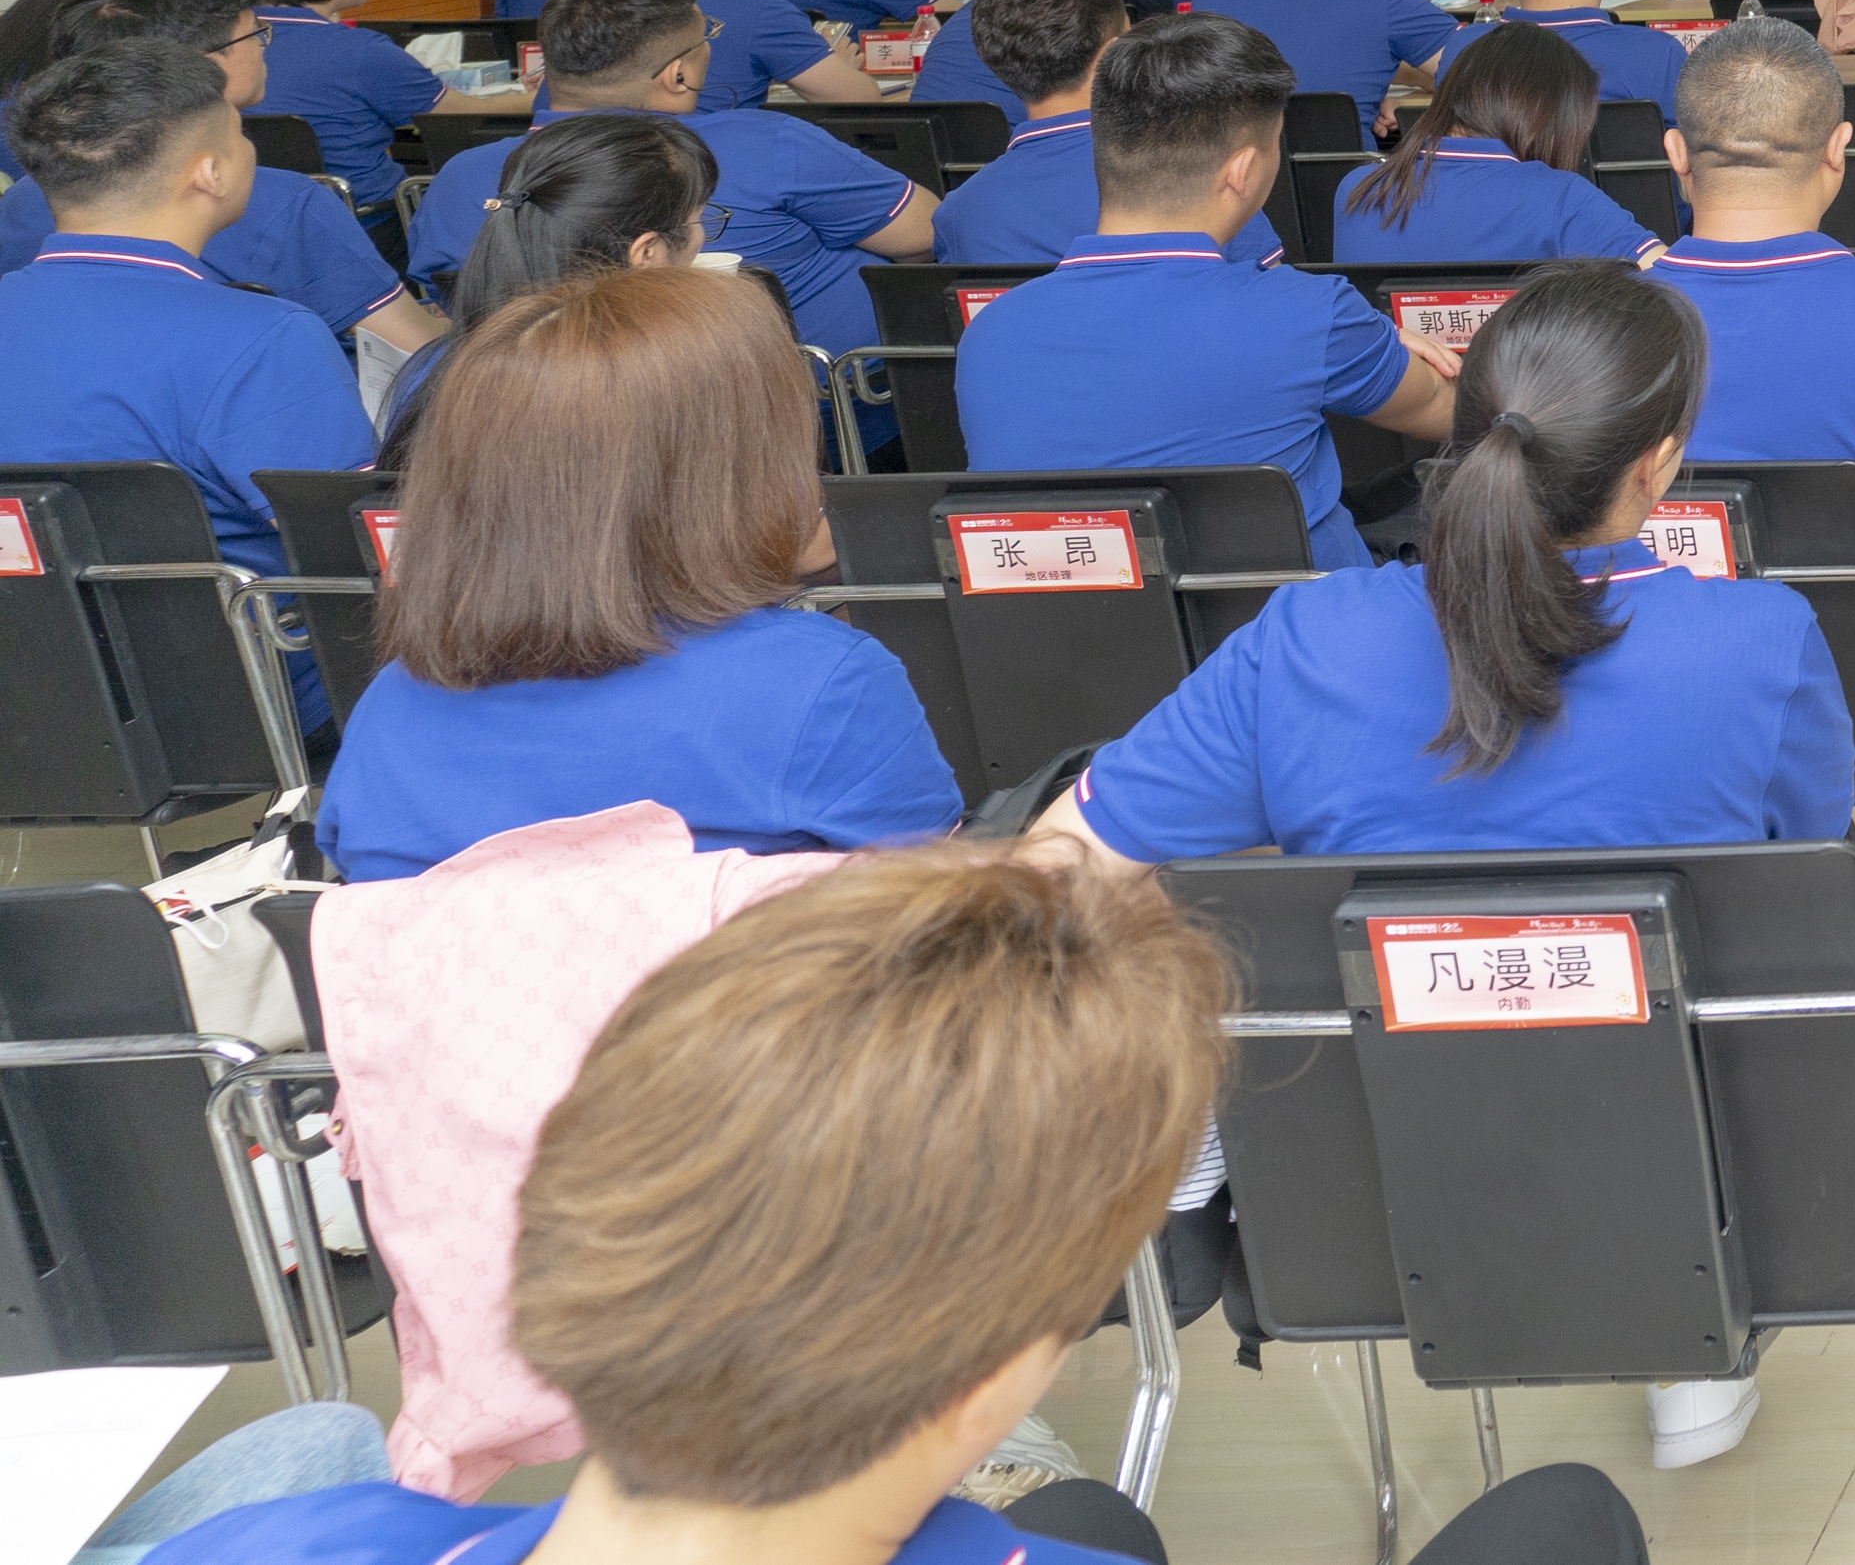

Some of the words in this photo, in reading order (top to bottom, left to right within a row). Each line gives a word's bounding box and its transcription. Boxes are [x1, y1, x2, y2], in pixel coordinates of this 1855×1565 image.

[1446, 335, 1473, 345] 地区经
[990, 536, 1098, 569] 张昂
[1024, 569, 1073, 582] 地区经理
[1426, 944, 1598, 995] 凡漫漫
[1496, 996, 1532, 1013] 内勤
